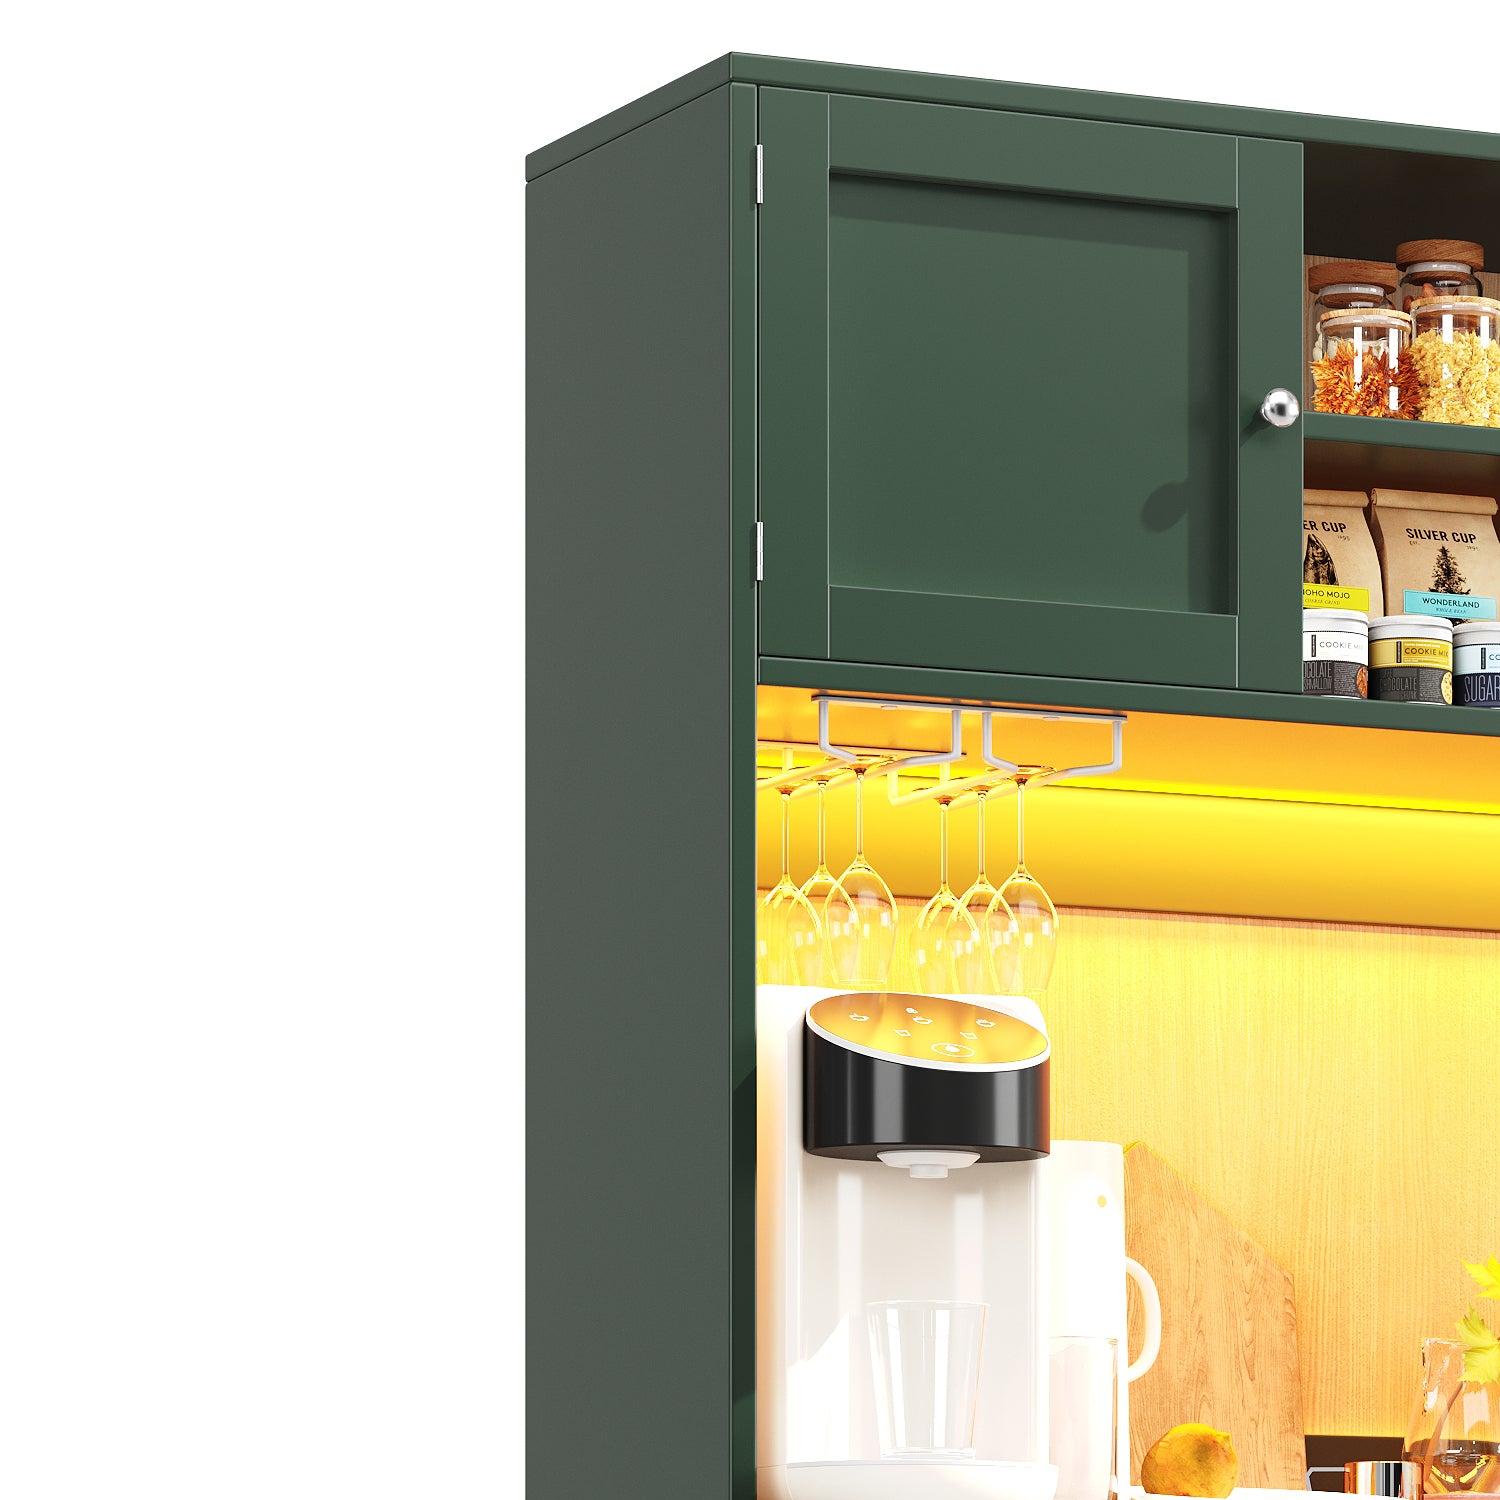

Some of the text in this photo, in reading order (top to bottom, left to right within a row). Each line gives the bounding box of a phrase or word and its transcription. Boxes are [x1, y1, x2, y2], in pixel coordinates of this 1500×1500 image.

[1321, 521, 1347, 533] CUP
[1405, 527, 1477, 544] SILVER CUP
[1326, 591, 1351, 599] MOJO
[1422, 597, 1480, 609] WONDERLAND
[1319, 641, 1352, 650] COOKIE
[1404, 647, 1437, 656] COOKIE
